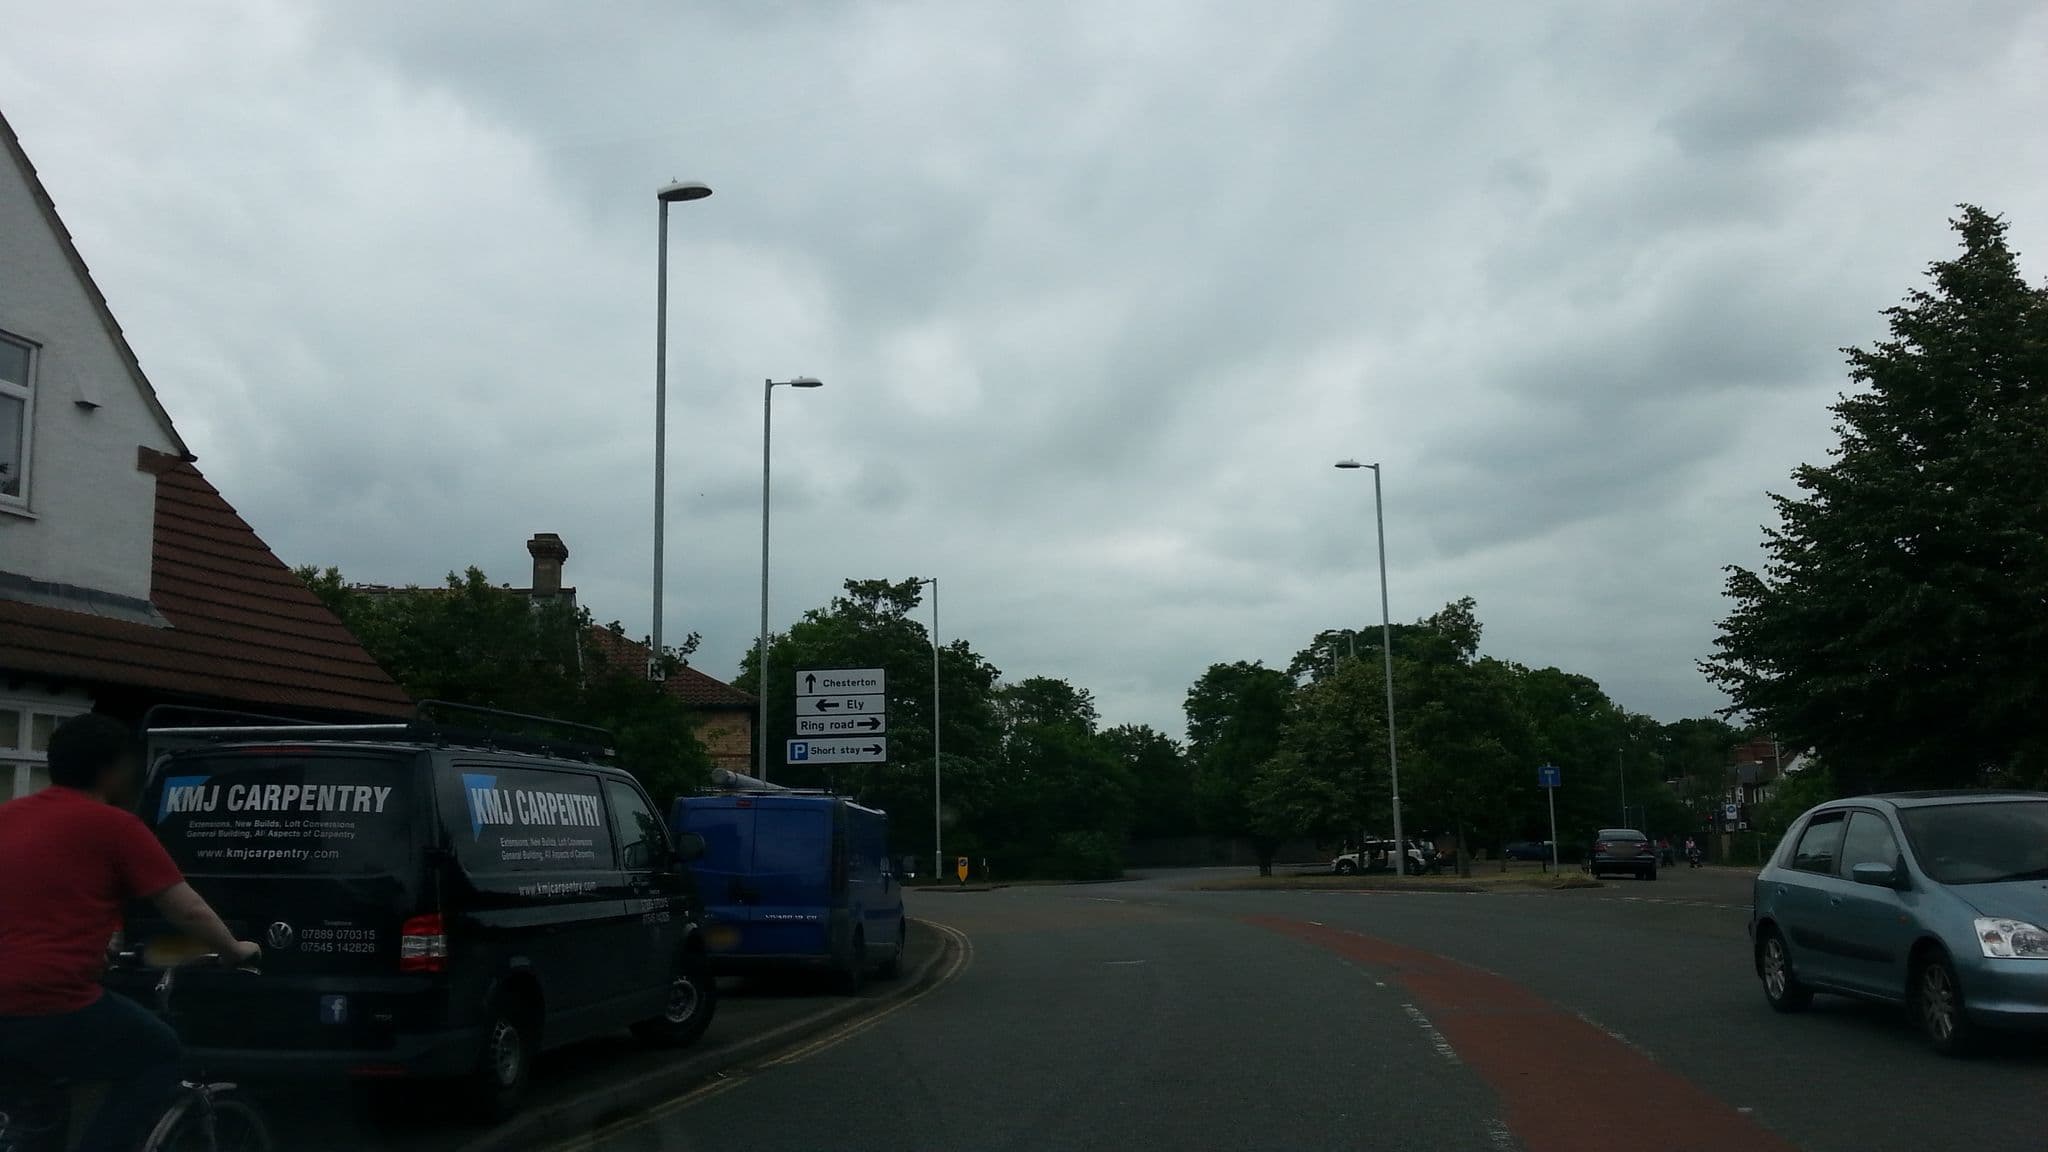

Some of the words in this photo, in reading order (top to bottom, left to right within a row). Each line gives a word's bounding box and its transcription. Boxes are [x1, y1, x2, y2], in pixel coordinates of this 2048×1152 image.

[823, 678, 877, 688] Chesterton
[847, 699, 864, 710] Ely
[801, 720, 825, 731] Ring
[830, 720, 854, 729] road
[794, 744, 806, 760] P
[810, 746, 836, 755] Short
[840, 746, 860, 755] stay
[166, 784, 220, 812] KMJ
[227, 784, 392, 813] CARPENTRY
[471, 787, 514, 825] KMJ
[515, 789, 600, 826] CARPENTRY
[235, 820, 252, 828] New
[254, 820, 282, 829] Builds,
[284, 820, 300, 828] Loft
[302, 820, 355, 829] Conversions
[186, 830, 216, 838] General
[267, 830, 301, 839] Aspects
[303, 830, 313, 838] of
[313, 830, 355, 840] Carpentry
[196, 848, 340, 860] www.kmjcarpentry.com
[301, 929, 333, 939] 07889
[336, 929, 375, 940] 070315
[300, 942, 333, 952] 07545
